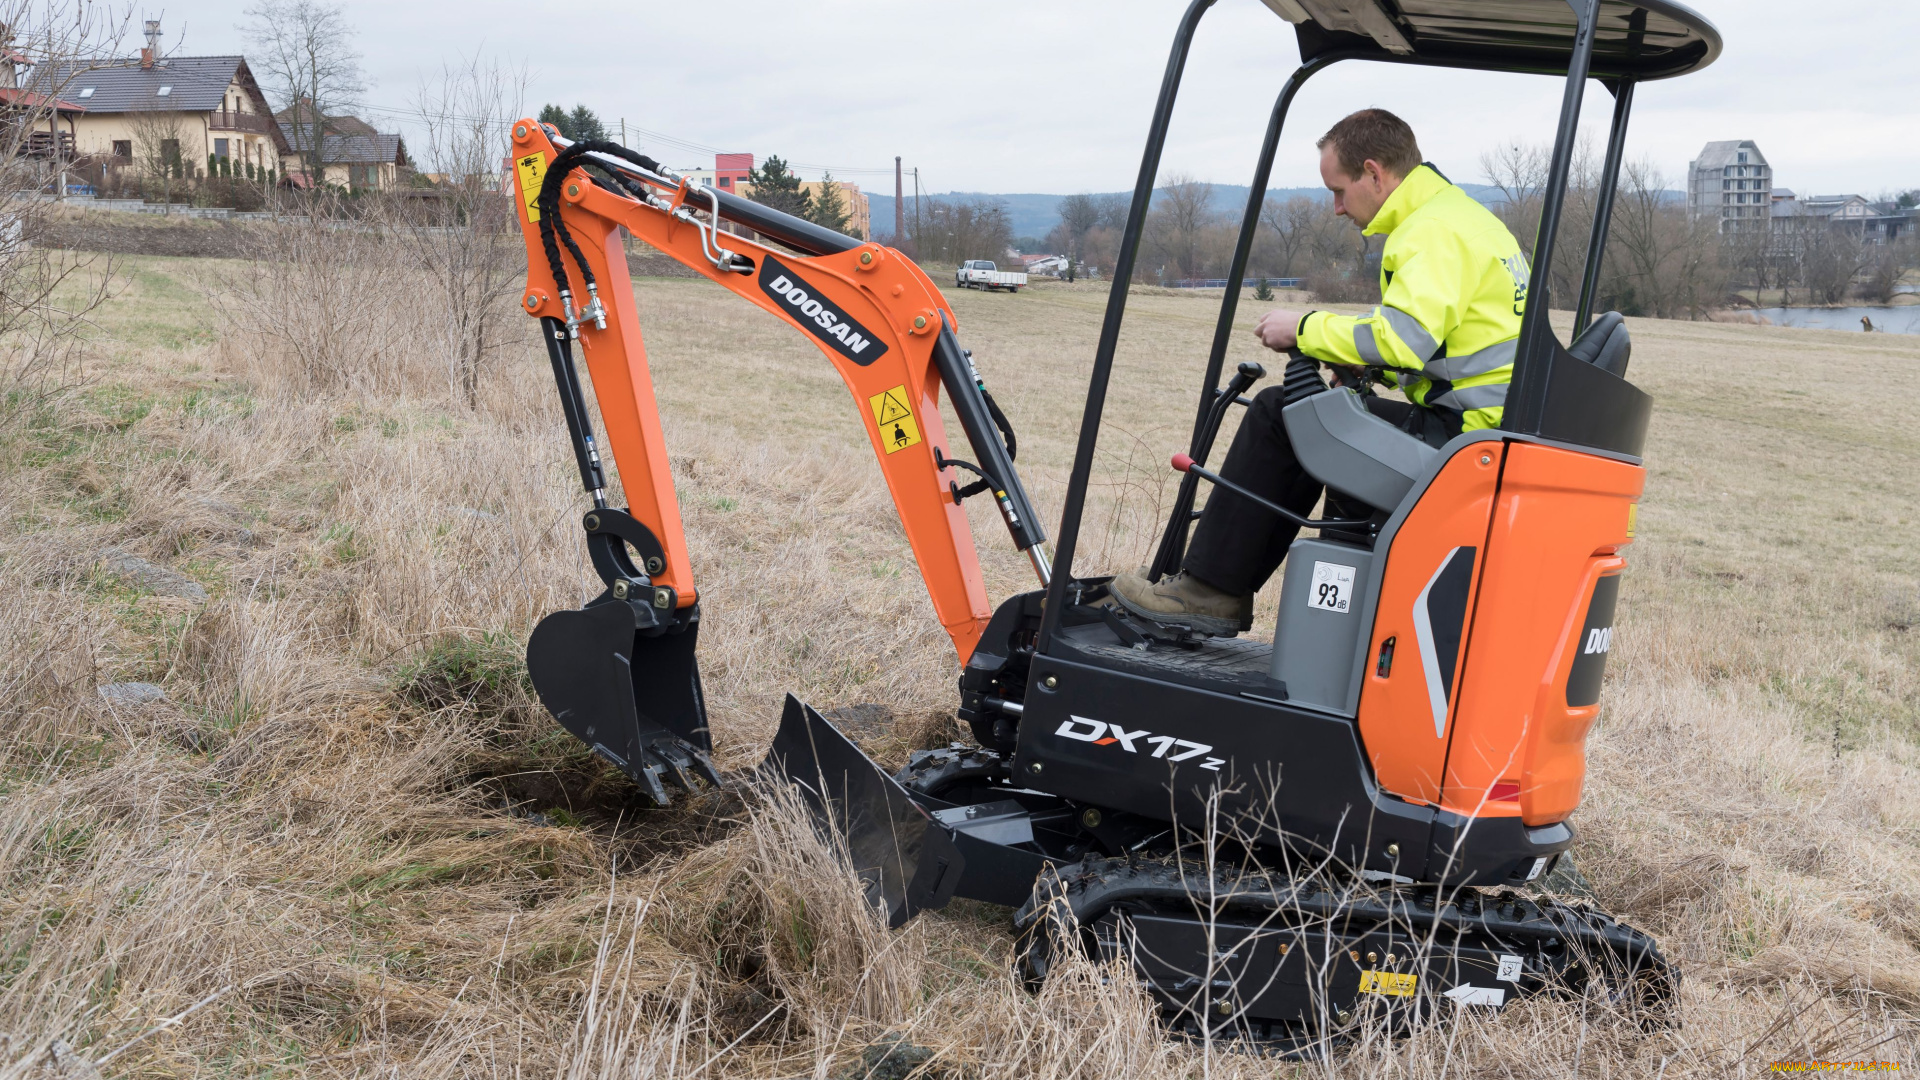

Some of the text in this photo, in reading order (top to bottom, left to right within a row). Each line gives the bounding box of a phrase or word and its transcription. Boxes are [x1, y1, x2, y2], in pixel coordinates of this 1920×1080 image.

[769, 275, 870, 354] DOOSAN
[1318, 583, 1347, 610] 93 dB
